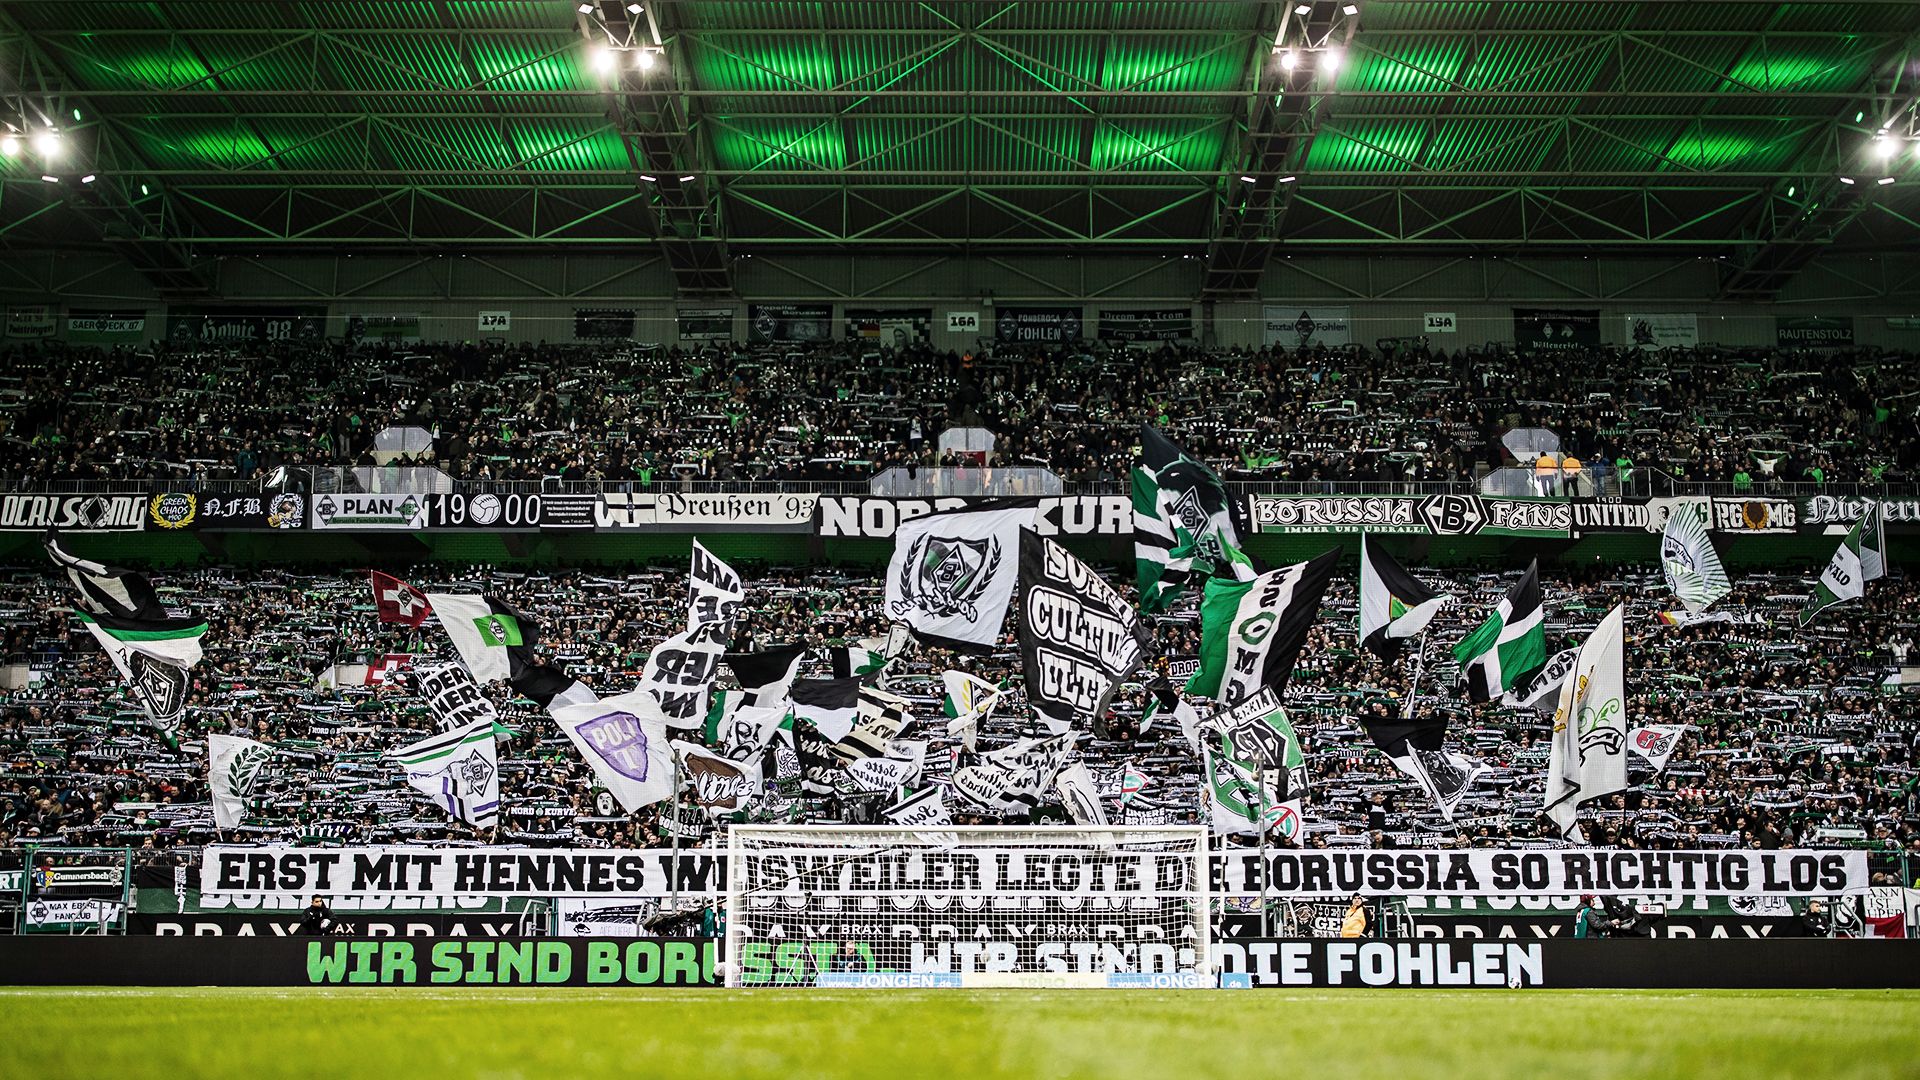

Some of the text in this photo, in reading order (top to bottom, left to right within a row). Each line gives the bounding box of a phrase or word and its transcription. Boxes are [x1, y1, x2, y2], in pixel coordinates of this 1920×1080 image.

[482, 315, 507, 326] 17A
[951, 317, 976, 327] 16A
[1267, 322, 1294, 331] Enztal
[1316, 322, 1347, 331] Fohlen
[1428, 318, 1453, 327] 15A
[266, 319, 294, 341] 98
[1017, 327, 1062, 341] FOHLEN
[1778, 329, 1853, 340] RAUTENSTOLZ
[163, 498, 187, 506] GREEN
[343, 500, 393, 514] PLAN
[659, 495, 771, 521] Preußen
[160, 505, 189, 515] CHAOS
[434, 494, 466, 524] 19
[505, 494, 541, 525] 00
[1255, 499, 1414, 525] BORUSSIA
[1490, 501, 1572, 529] FANS
[1572, 503, 1649, 527] UNITED
[1033, 497, 1134, 536] KUR
[1285, 525, 1329, 533] IMMER
[511, 807, 535, 816] NORD
[217, 853, 341, 891] ERST
[351, 853, 442, 891] MIT
[453, 855, 645, 892] HENNES
[995, 854, 1141, 892] LEGTE
[1243, 853, 1479, 891] BORUSSIA
[1492, 853, 1550, 890] SO
[1561, 853, 1749, 891] RICHTIG
[1761, 854, 1848, 892] LOS
[841, 924, 883, 935] BRAX
[1046, 924, 1089, 936] BRAX
[307, 941, 417, 983] WIR
[430, 941, 572, 983] SIND
[911, 942, 1017, 973] WIR
[1327, 941, 1544, 985] FOHLEN
[858, 973, 935, 988] JONGEN
